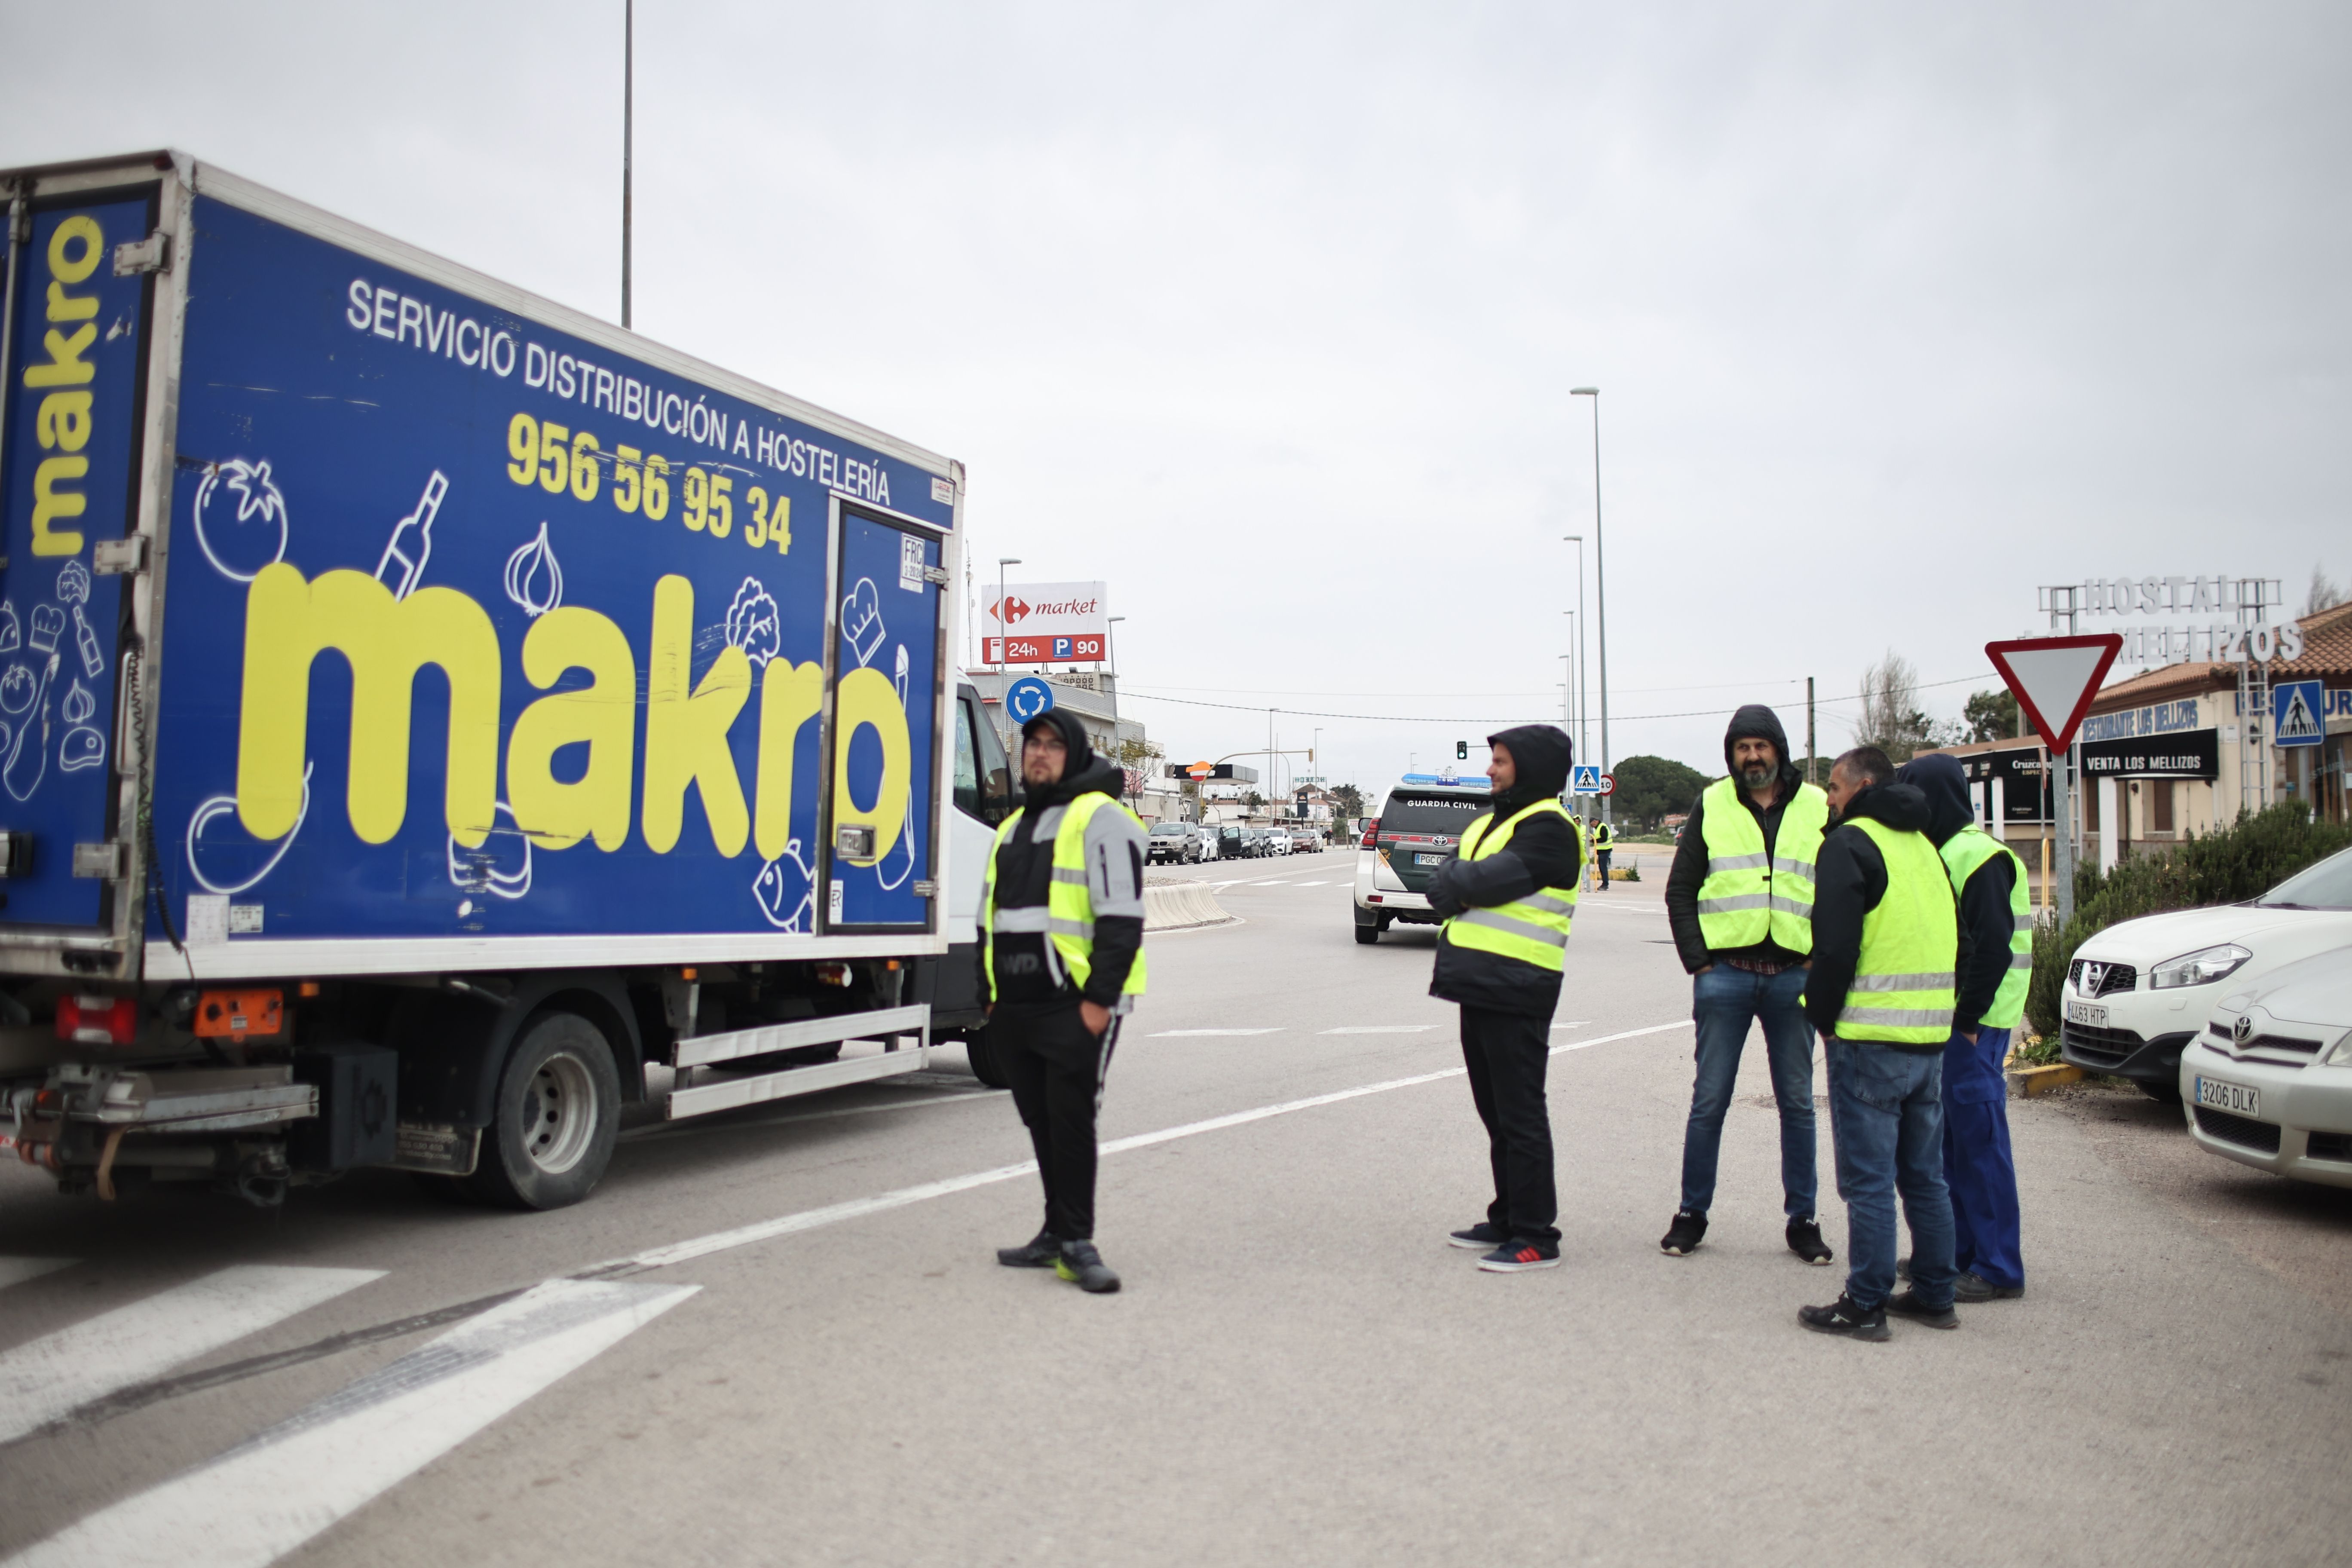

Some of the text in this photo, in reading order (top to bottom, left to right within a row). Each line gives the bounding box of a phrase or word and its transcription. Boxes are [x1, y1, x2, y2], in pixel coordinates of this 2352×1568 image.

[24, 215, 103, 557] makro
[346, 279, 891, 506] SERVICIO DISTRIBUCIÓN A HOSTELERÍA
[506, 413, 792, 555] 956 56 95 34
[904, 539, 923, 564] FRC
[905, 565, 922, 579] 3-2024
[1035, 598, 1098, 616] market
[2085, 575, 2240, 616] HOSTAL
[1009, 639, 1099, 657] 24h P 90
[2112, 621, 2303, 665] MELLIZOS
[236, 560, 912, 868] makro
[2082, 699, 2199, 741] RESTAURANTE LOS MELLIZOS
[2012, 760, 2052, 770] Cruzcamp
[2087, 755, 2201, 770] VENTA LOS MELLIZOS
[1453, 802, 1477, 810] CIVIL
[1421, 855, 1436, 864] PGC
[2071, 1004, 2106, 1025] 4463 HTP
[2202, 1081, 2256, 1113] 3206 DLK
